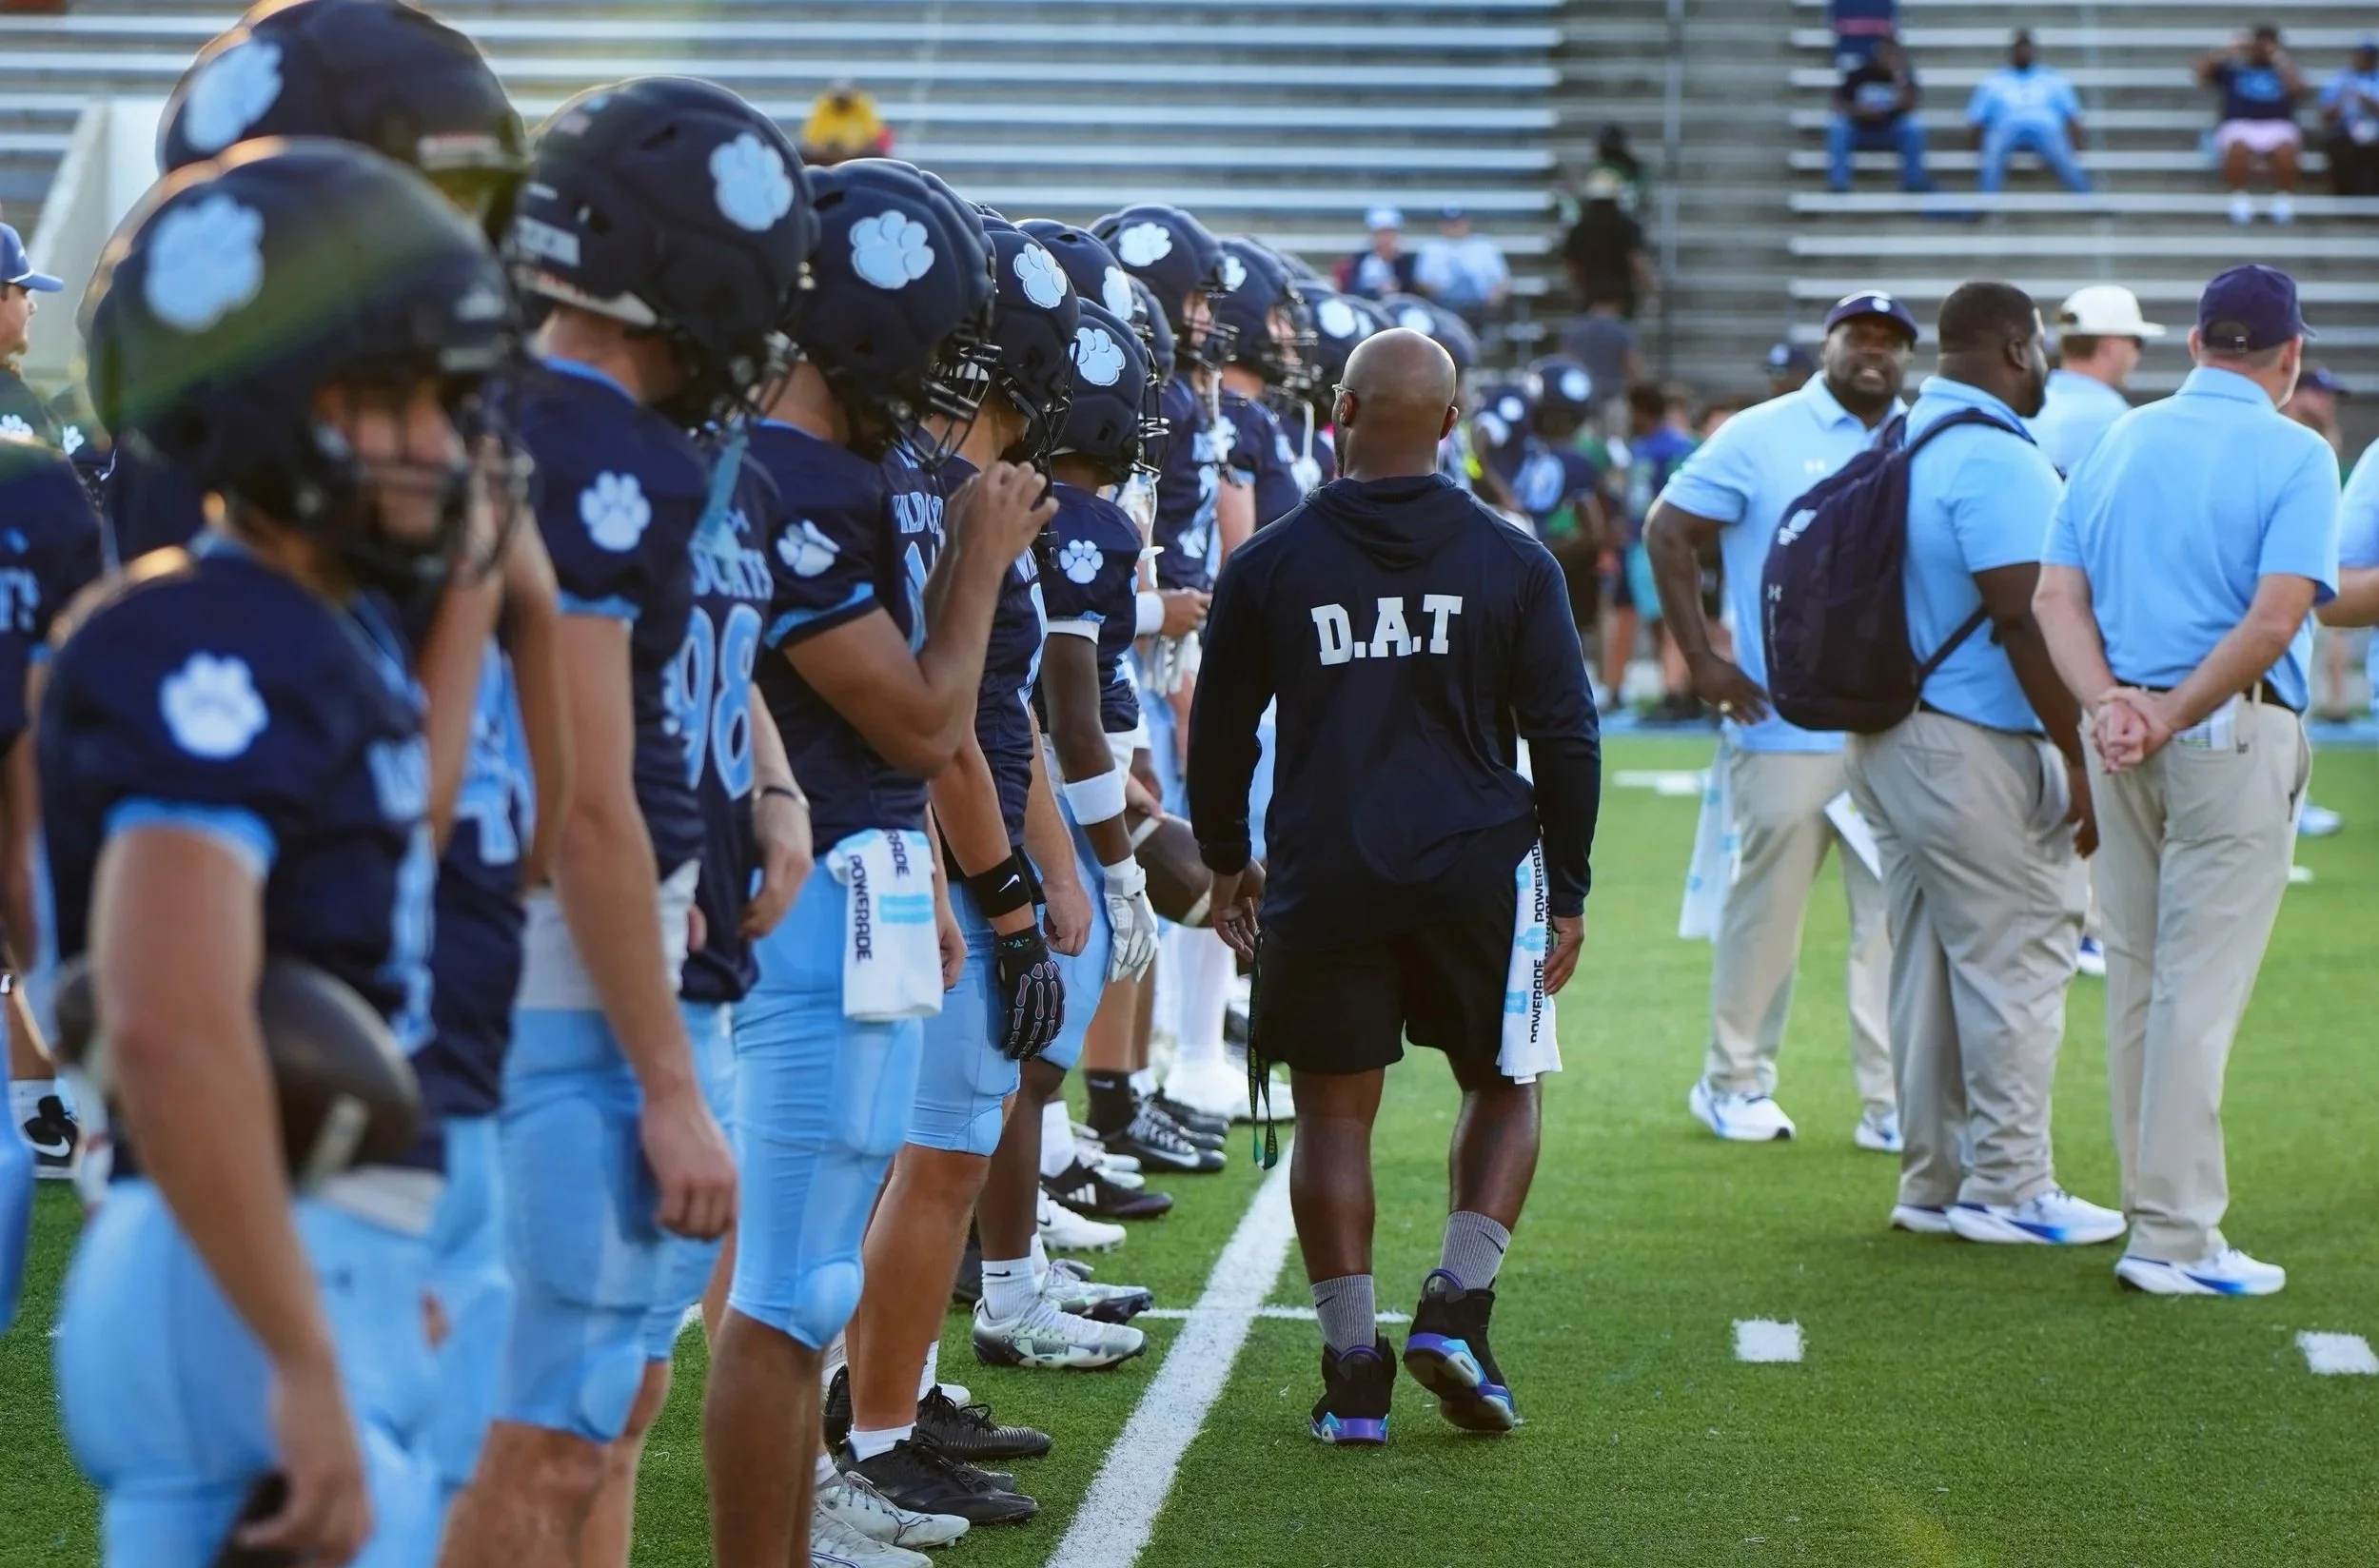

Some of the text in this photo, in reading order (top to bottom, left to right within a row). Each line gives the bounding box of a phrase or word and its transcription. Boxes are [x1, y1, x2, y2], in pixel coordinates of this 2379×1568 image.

[1310, 594, 1464, 666] D.A.T
[678, 602, 762, 801] 98
[849, 854, 873, 965] POWERADE
